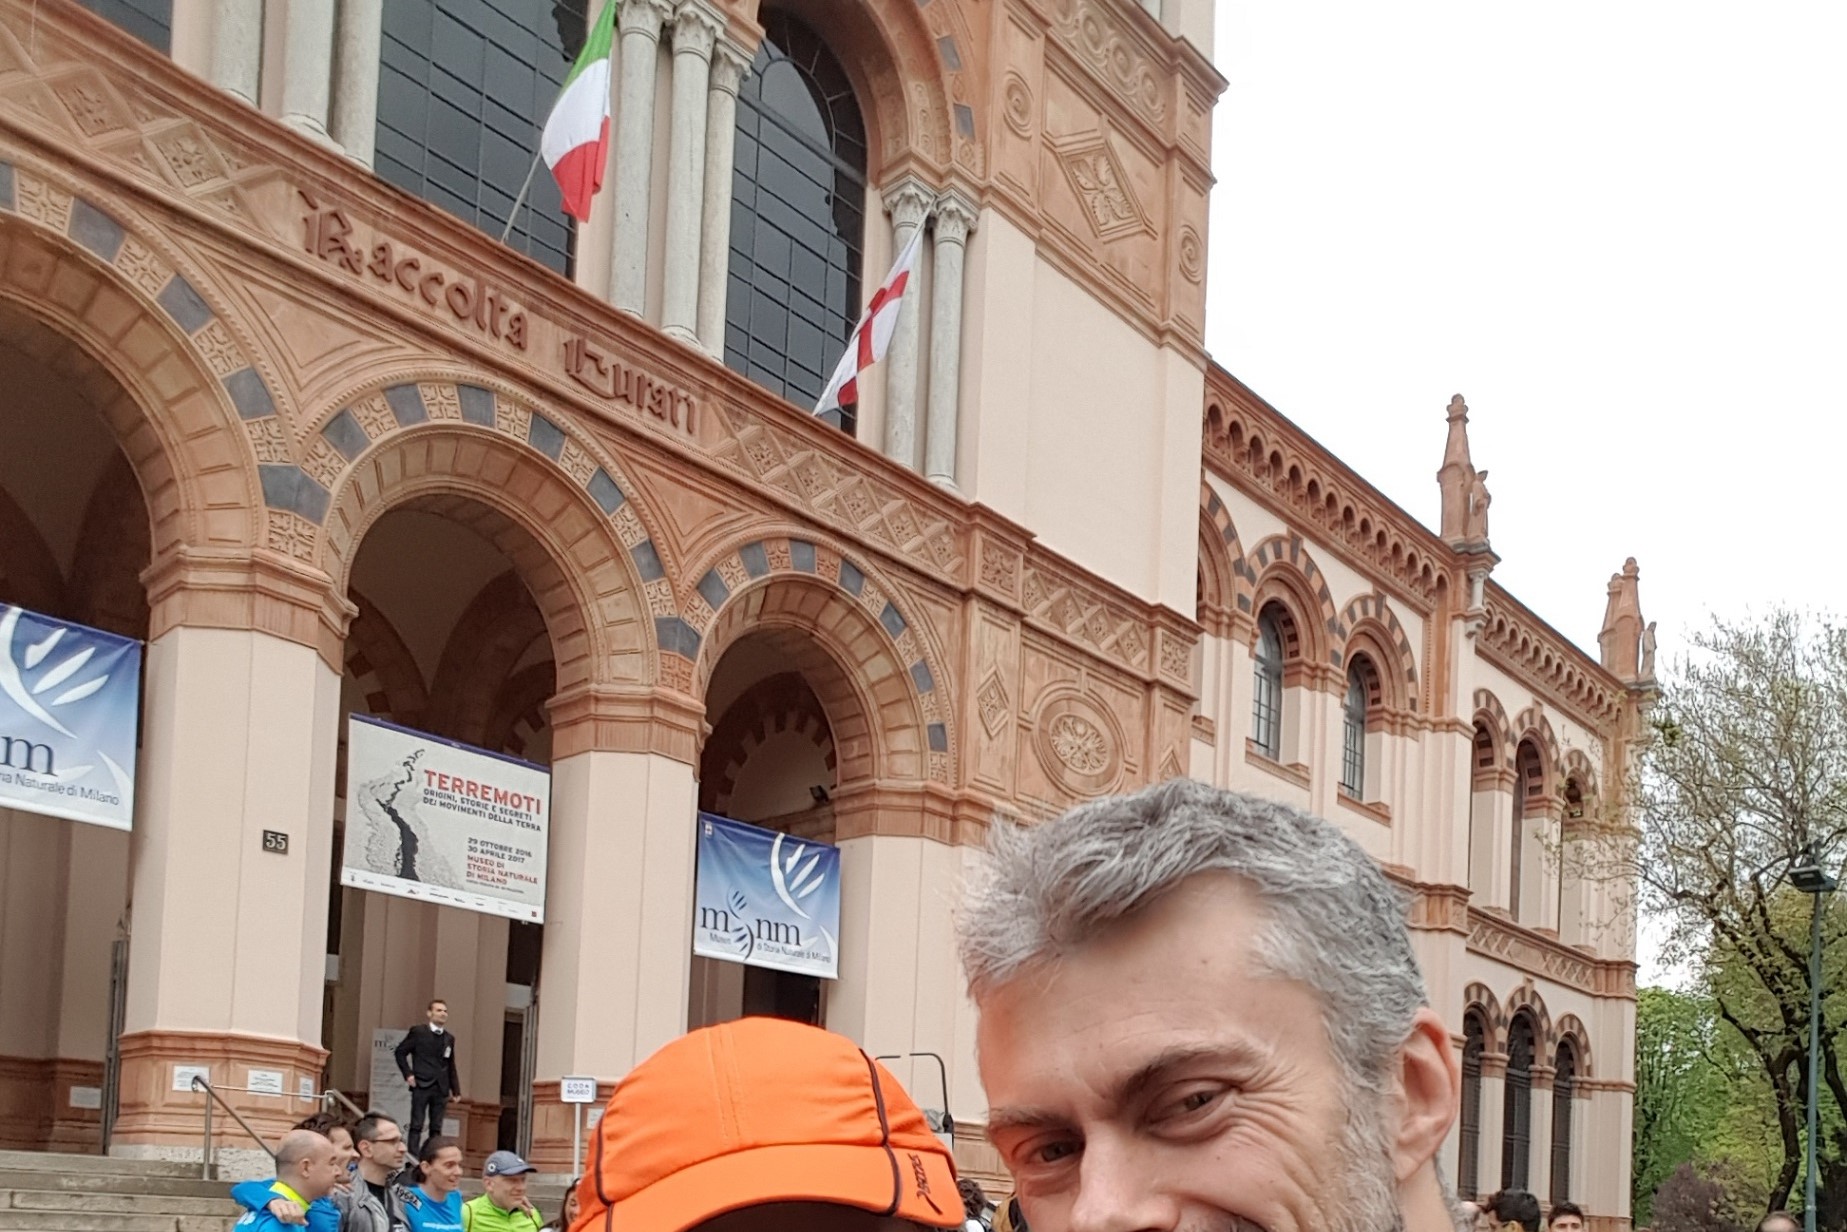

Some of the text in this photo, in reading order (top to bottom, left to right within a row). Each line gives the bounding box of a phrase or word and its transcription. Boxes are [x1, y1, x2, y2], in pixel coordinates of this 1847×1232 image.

[300, 190, 528, 352] Raccolta
[80, 787, 120, 806] Milano
[424, 769, 541, 815] TERREMOTI
[423, 788, 458, 803] ORIGINI,
[460, 797, 489, 811] STORIE
[499, 807, 532, 822] SEGRETI
[423, 796, 541, 832] DEI MOVIMENTI DELLA TERRA
[265, 832, 286, 850] 55
[480, 839, 513, 853] OTTOBRE
[467, 854, 495, 867] MUSEO
[480, 849, 506, 860] APRILE
[507, 854, 525, 864] 2017
[467, 863, 538, 885] STORIA NATURALE
[477, 874, 508, 885] MILANO
